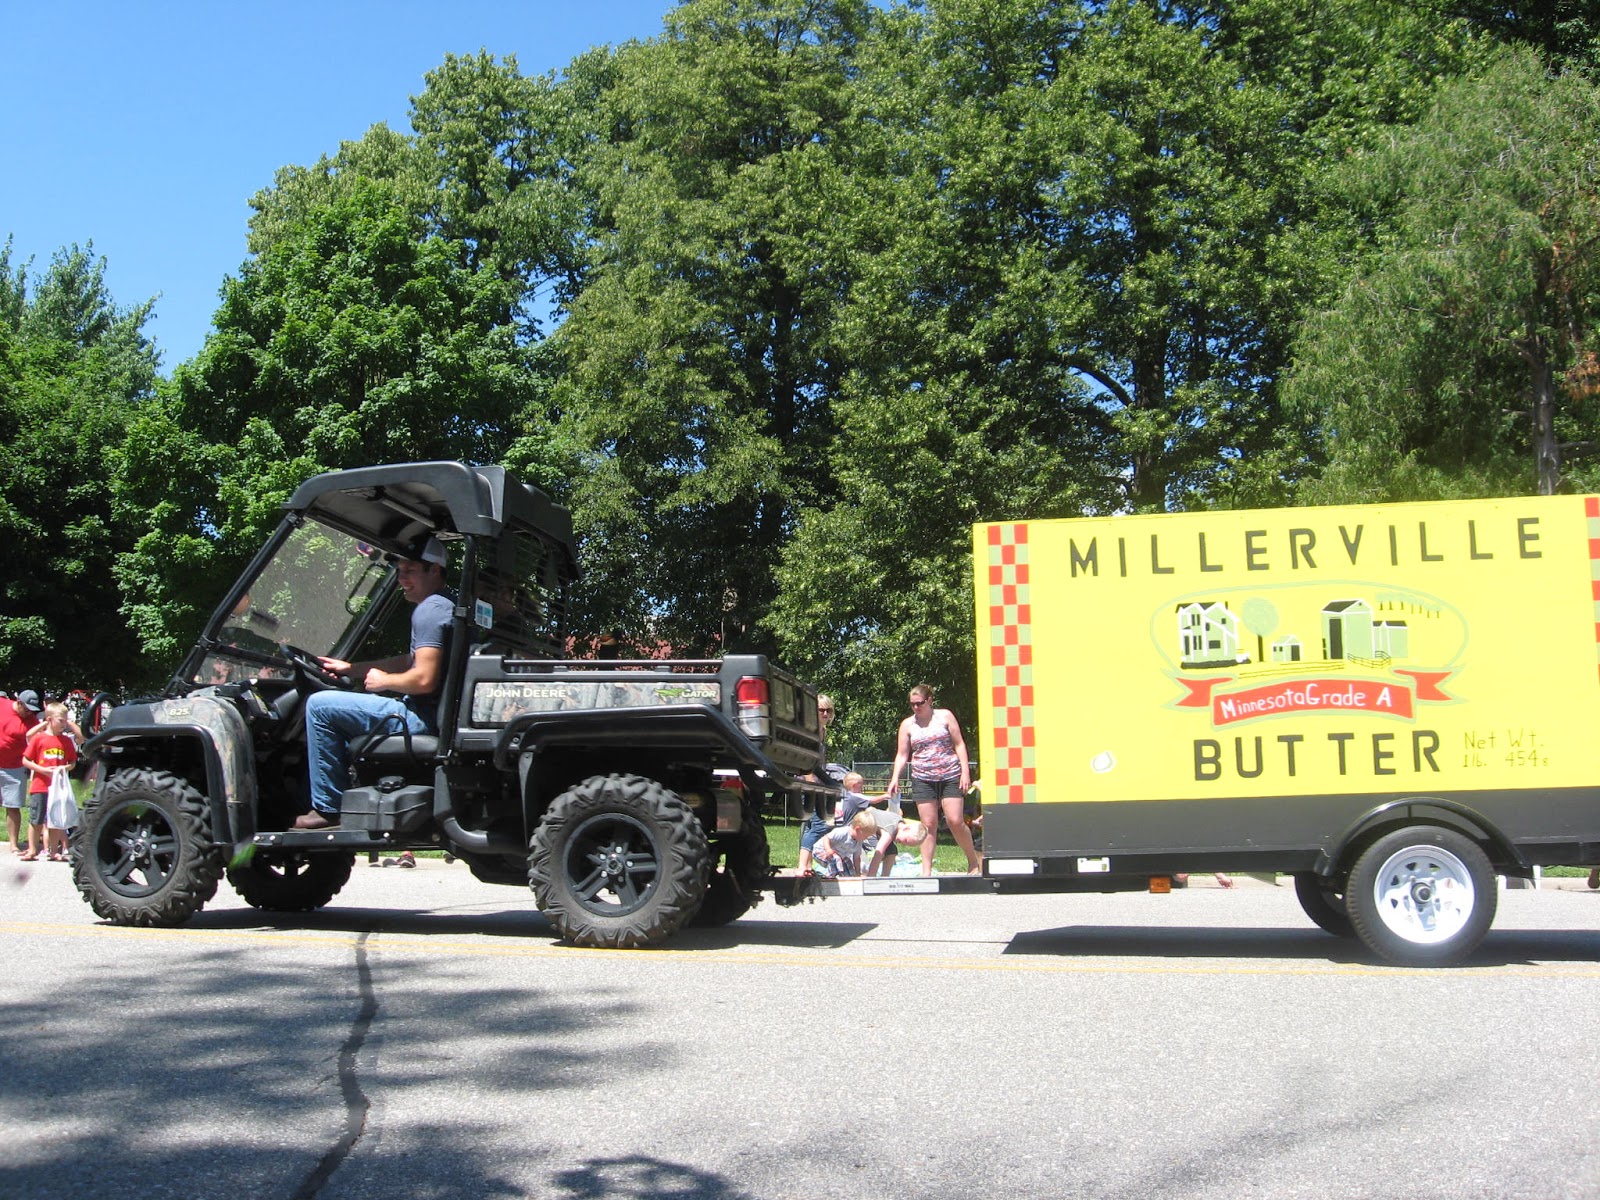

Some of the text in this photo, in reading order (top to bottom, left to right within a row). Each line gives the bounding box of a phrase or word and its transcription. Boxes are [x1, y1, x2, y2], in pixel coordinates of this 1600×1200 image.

[1070, 517, 1543, 577] MILLERVILLE
[486, 688, 566, 698] JOHN DEERE
[681, 689, 717, 698] GATOR
[1376, 686, 1392, 707] A
[1464, 731, 1496, 749] Net
[1194, 730, 1441, 781] BUTTER
